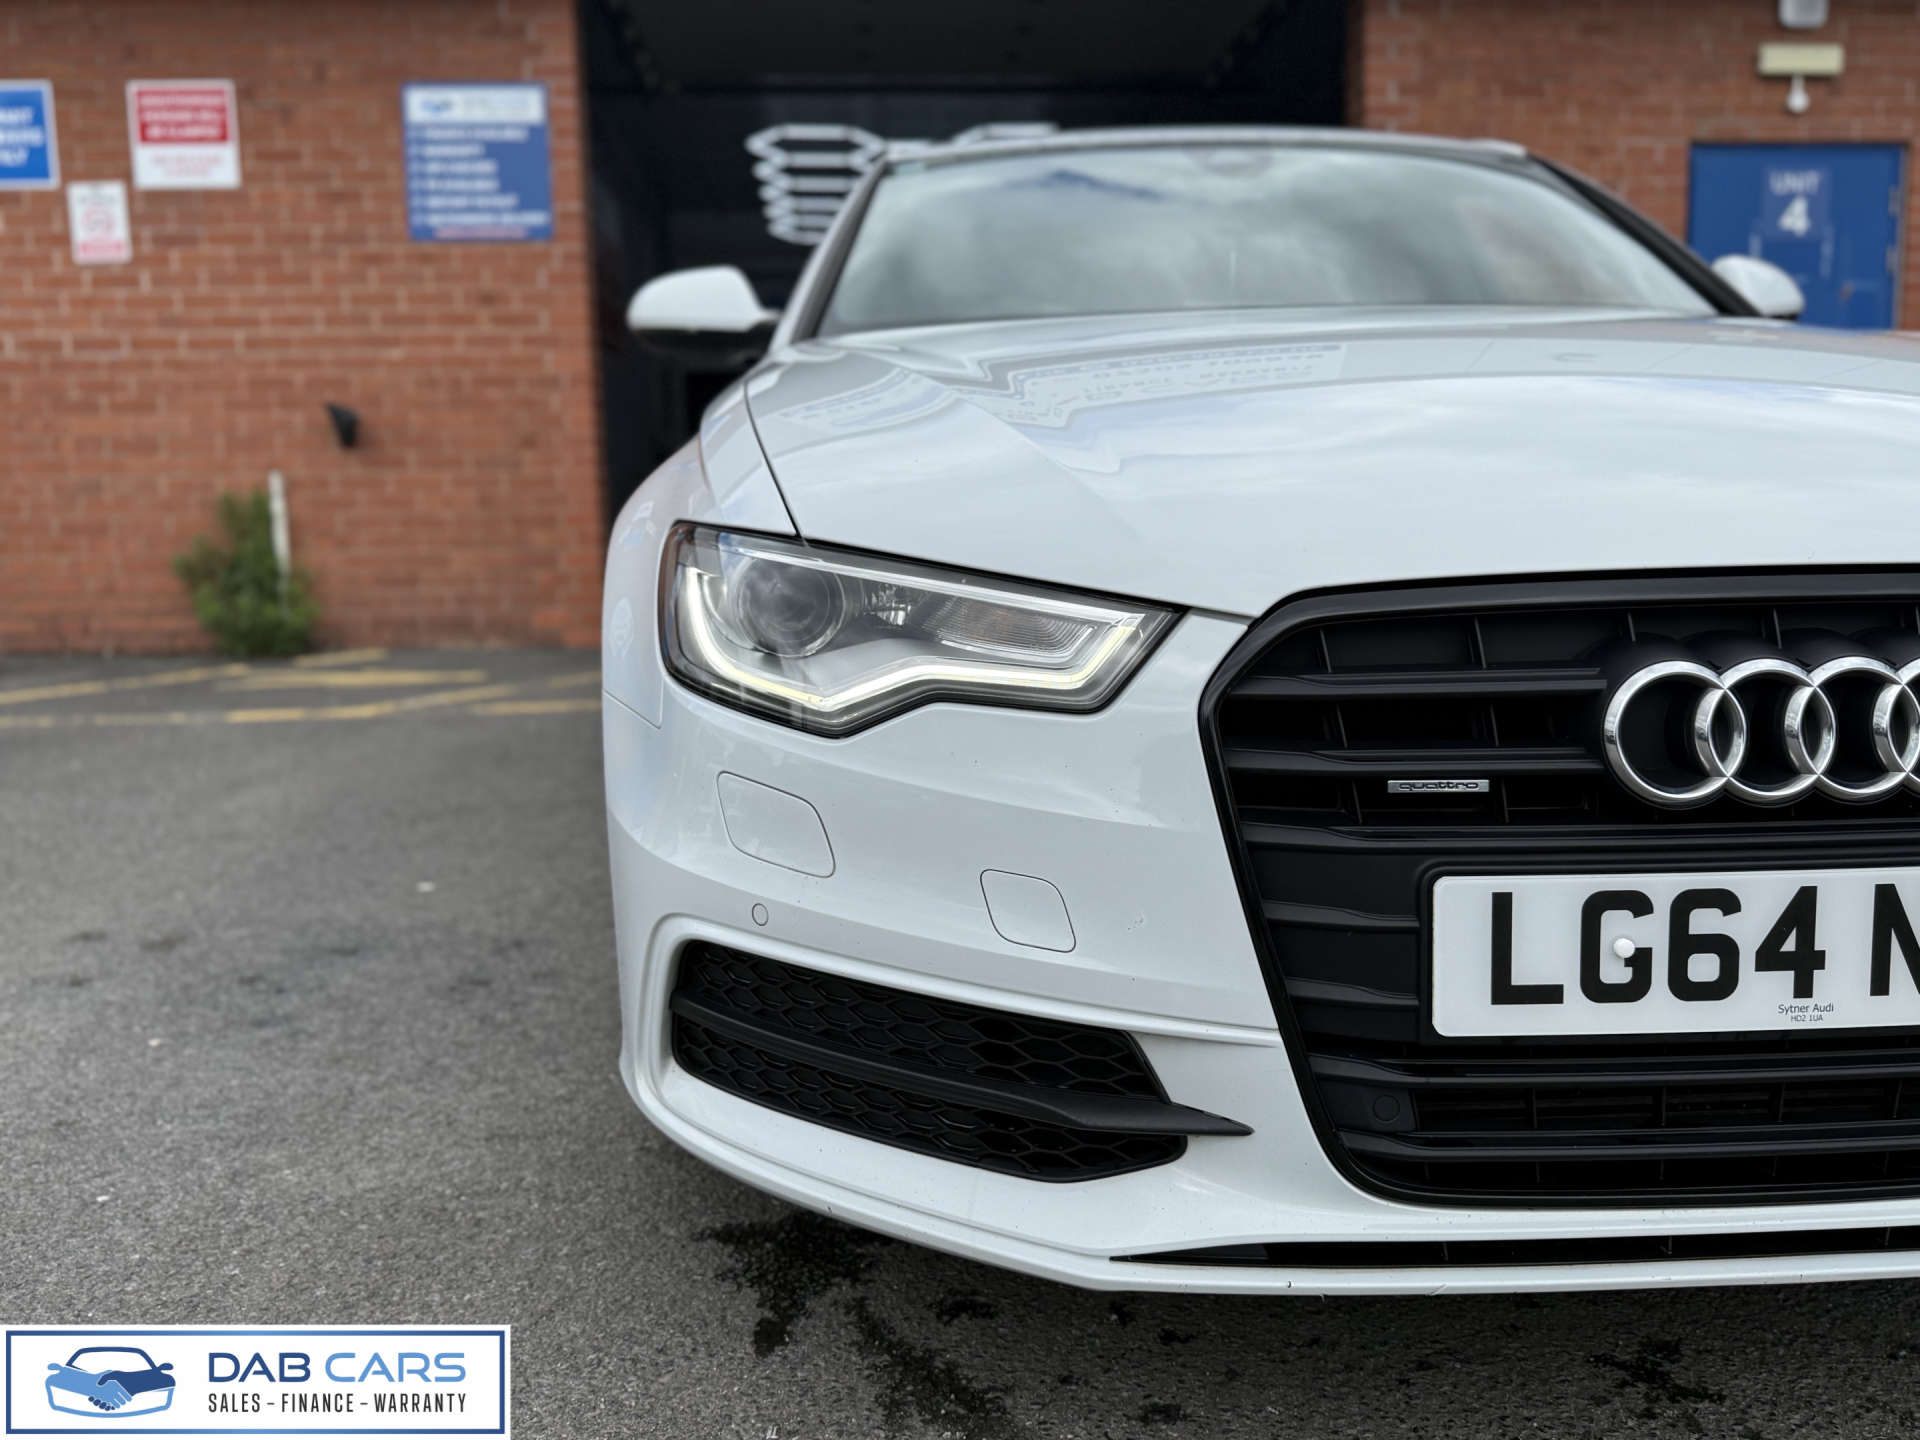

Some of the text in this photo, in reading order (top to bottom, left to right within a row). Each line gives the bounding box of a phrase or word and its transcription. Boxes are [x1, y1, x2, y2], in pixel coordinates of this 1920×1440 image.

[1768, 170, 1821, 195] UNIT
[1778, 195, 1812, 237] 4
[1399, 782, 1479, 792] quattro
[1490, 886, 1826, 1005] LG64
[1777, 1002, 1834, 1015] Sytner Audi
[1790, 1014, 1806, 1022] HD2
